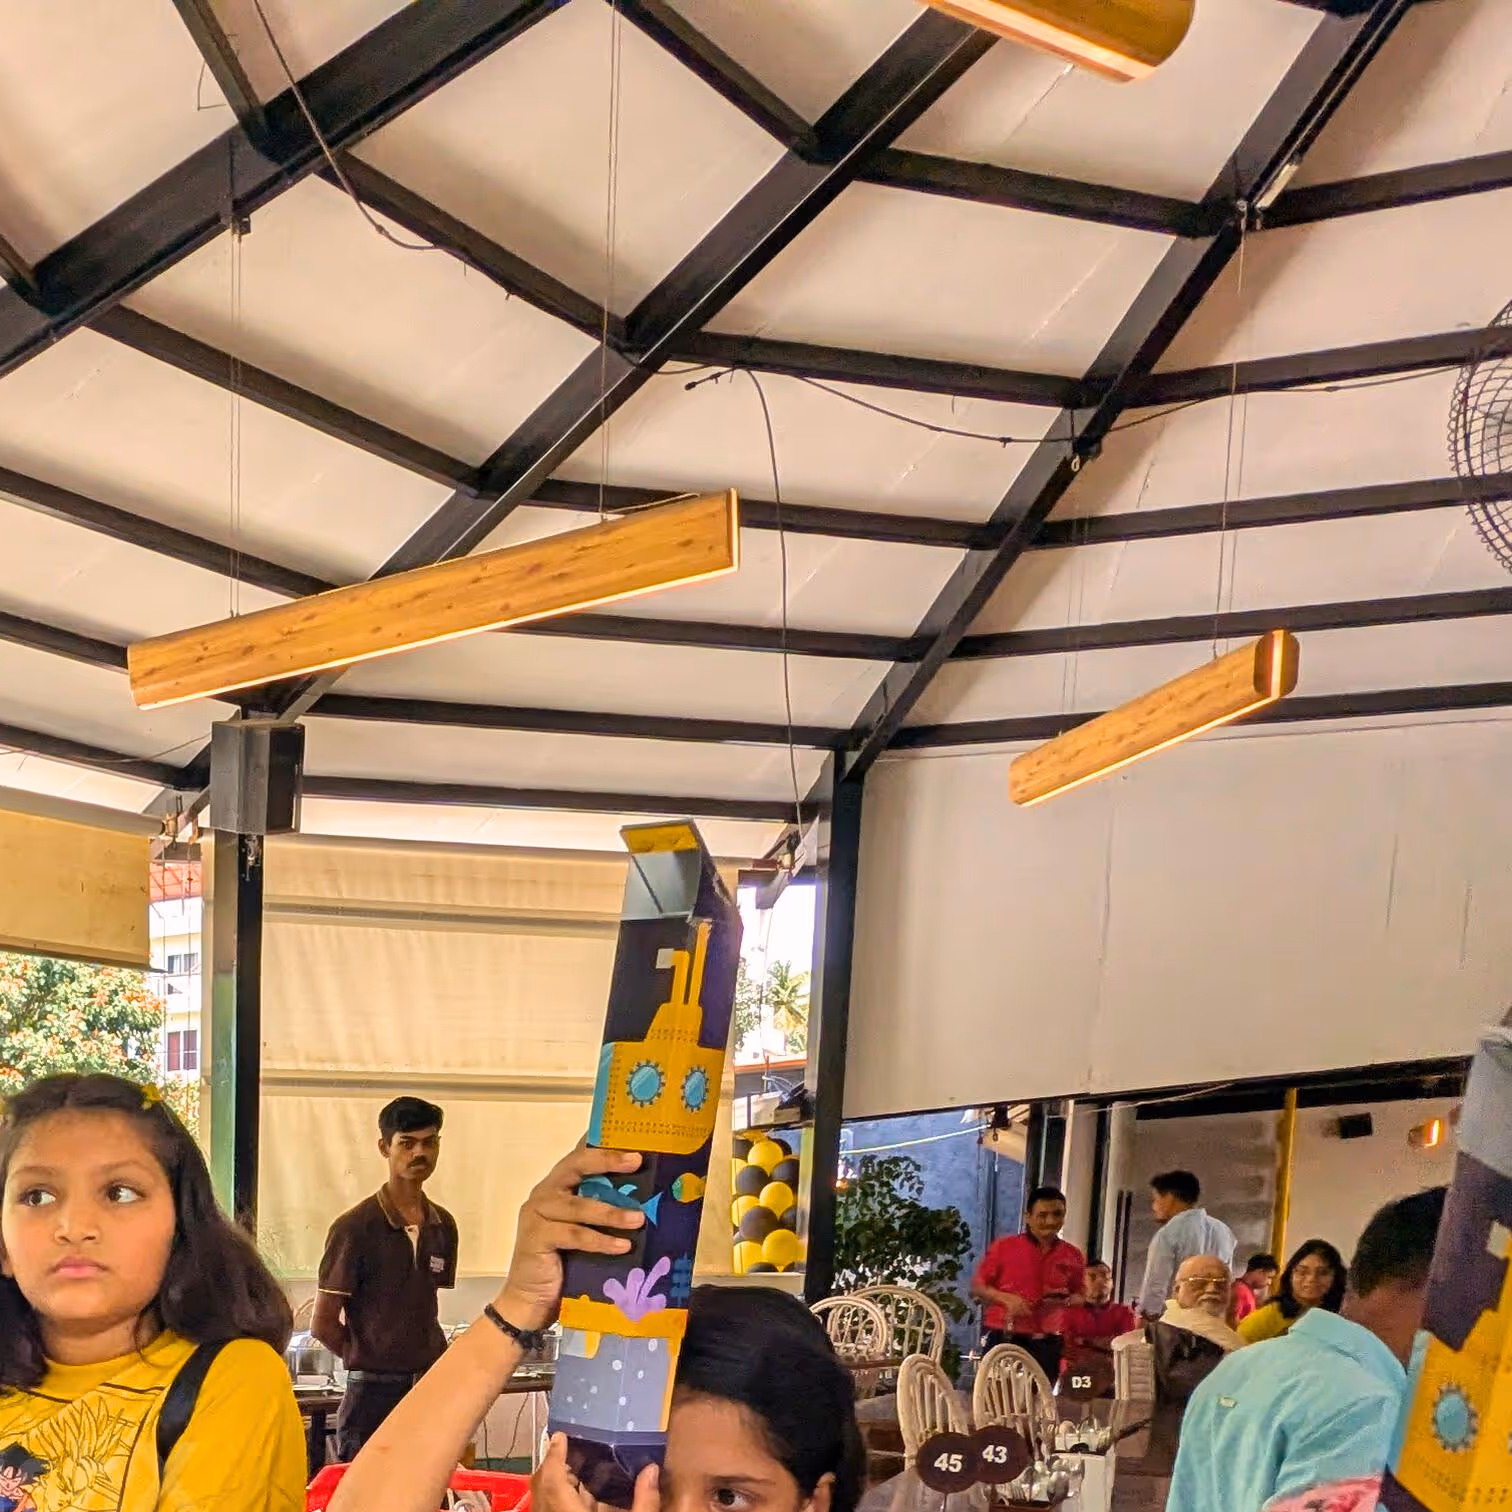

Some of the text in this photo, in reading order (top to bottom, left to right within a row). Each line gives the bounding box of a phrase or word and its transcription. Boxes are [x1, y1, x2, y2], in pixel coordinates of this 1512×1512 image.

[1072, 1376, 1092, 1388] D3
[934, 1453, 963, 1472] 45
[982, 1445, 1007, 1463] 43
